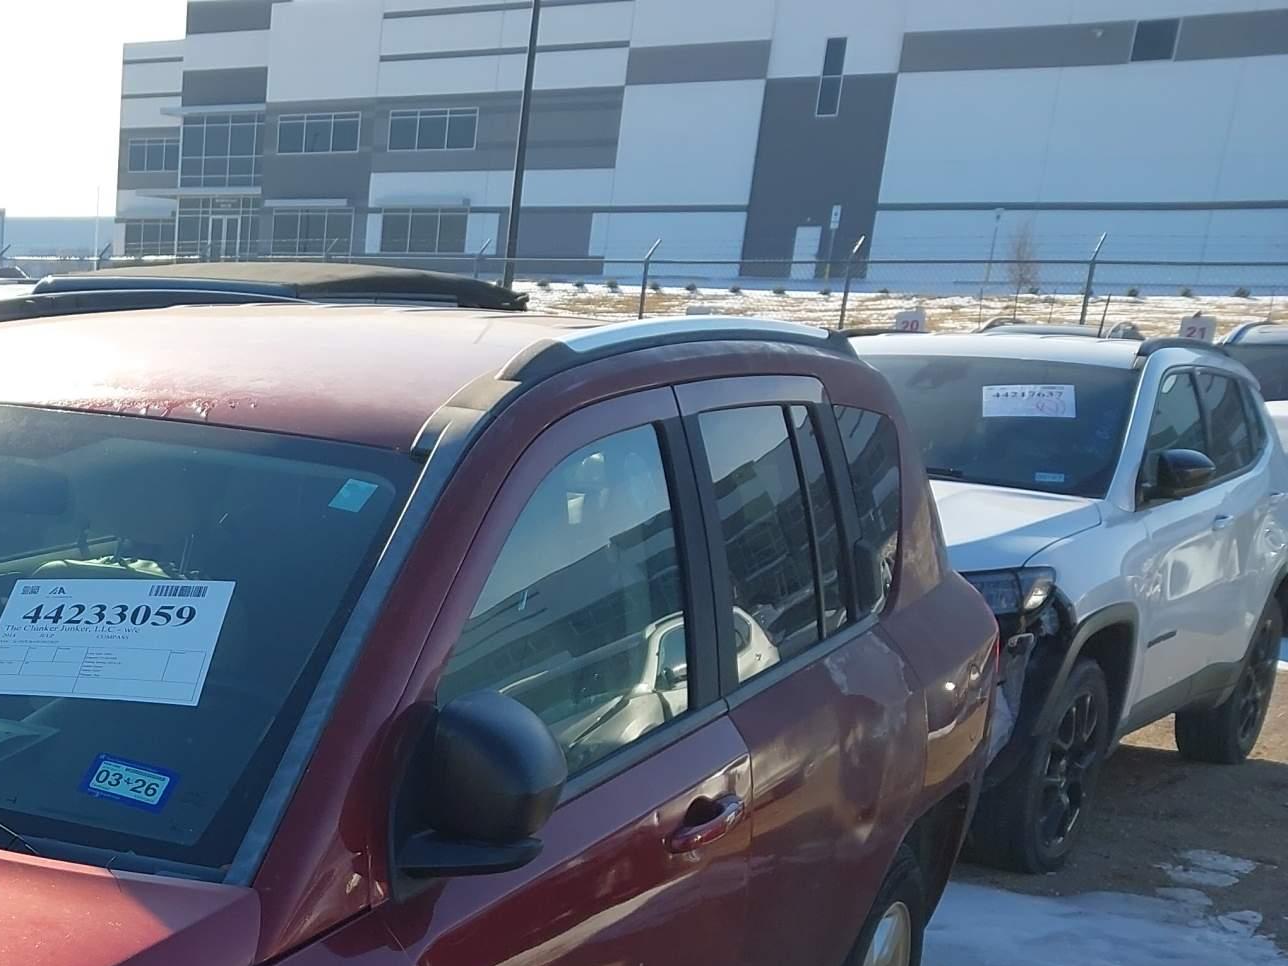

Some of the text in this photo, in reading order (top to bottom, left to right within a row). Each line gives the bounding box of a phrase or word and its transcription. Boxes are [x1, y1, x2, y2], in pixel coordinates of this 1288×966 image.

[901, 319, 920, 331] 20
[1185, 326, 1208, 340] 21
[22, 604, 197, 627] 44233059
